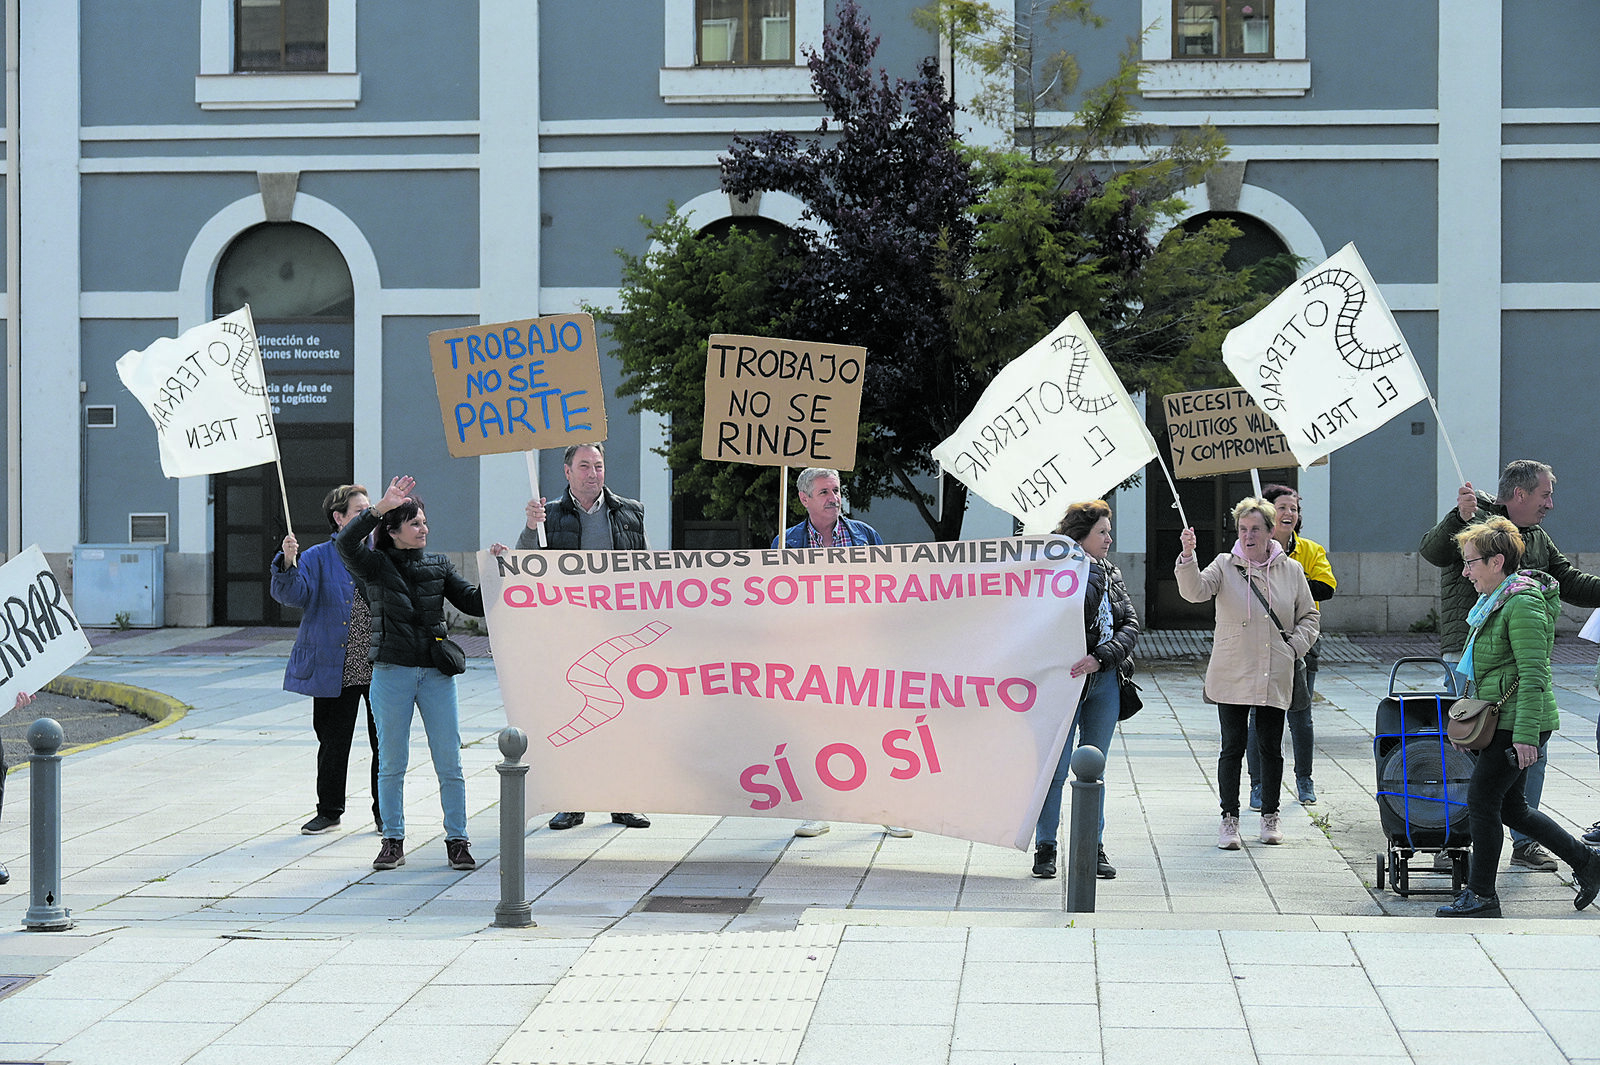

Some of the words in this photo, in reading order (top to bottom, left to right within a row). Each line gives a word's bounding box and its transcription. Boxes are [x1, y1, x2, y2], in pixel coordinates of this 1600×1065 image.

[294, 349, 340, 359] Noroeste
[307, 335, 320, 346] de
[444, 320, 583, 369] TROBAJO
[466, 369, 502, 398] NO
[508, 360, 549, 392] SE
[712, 344, 860, 384] TROBAJO
[282, 383, 295, 393] de
[297, 381, 318, 393] Área
[320, 383, 333, 393] de
[282, 393, 328, 406] Logísticos
[728, 389, 771, 418] NO
[788, 394, 832, 423] SE
[454, 388, 592, 442] PARTE
[1169, 416, 1238, 443] POLITICOS
[717, 421, 832, 460] RINDE
[1173, 446, 1185, 466] Y
[498, 553, 548, 578] NO
[558, 550, 751, 576] QUEREMOS
[762, 539, 1085, 566] ENFRENTAMIENTOS
[503, 577, 732, 611] QUEREMOS
[744, 568, 1080, 606] SOTERRAMIENTO
[0, 570, 78, 687] RRAR
[740, 742, 803, 811] SÍ
[815, 742, 868, 792] O
[882, 714, 942, 780] SÍ
